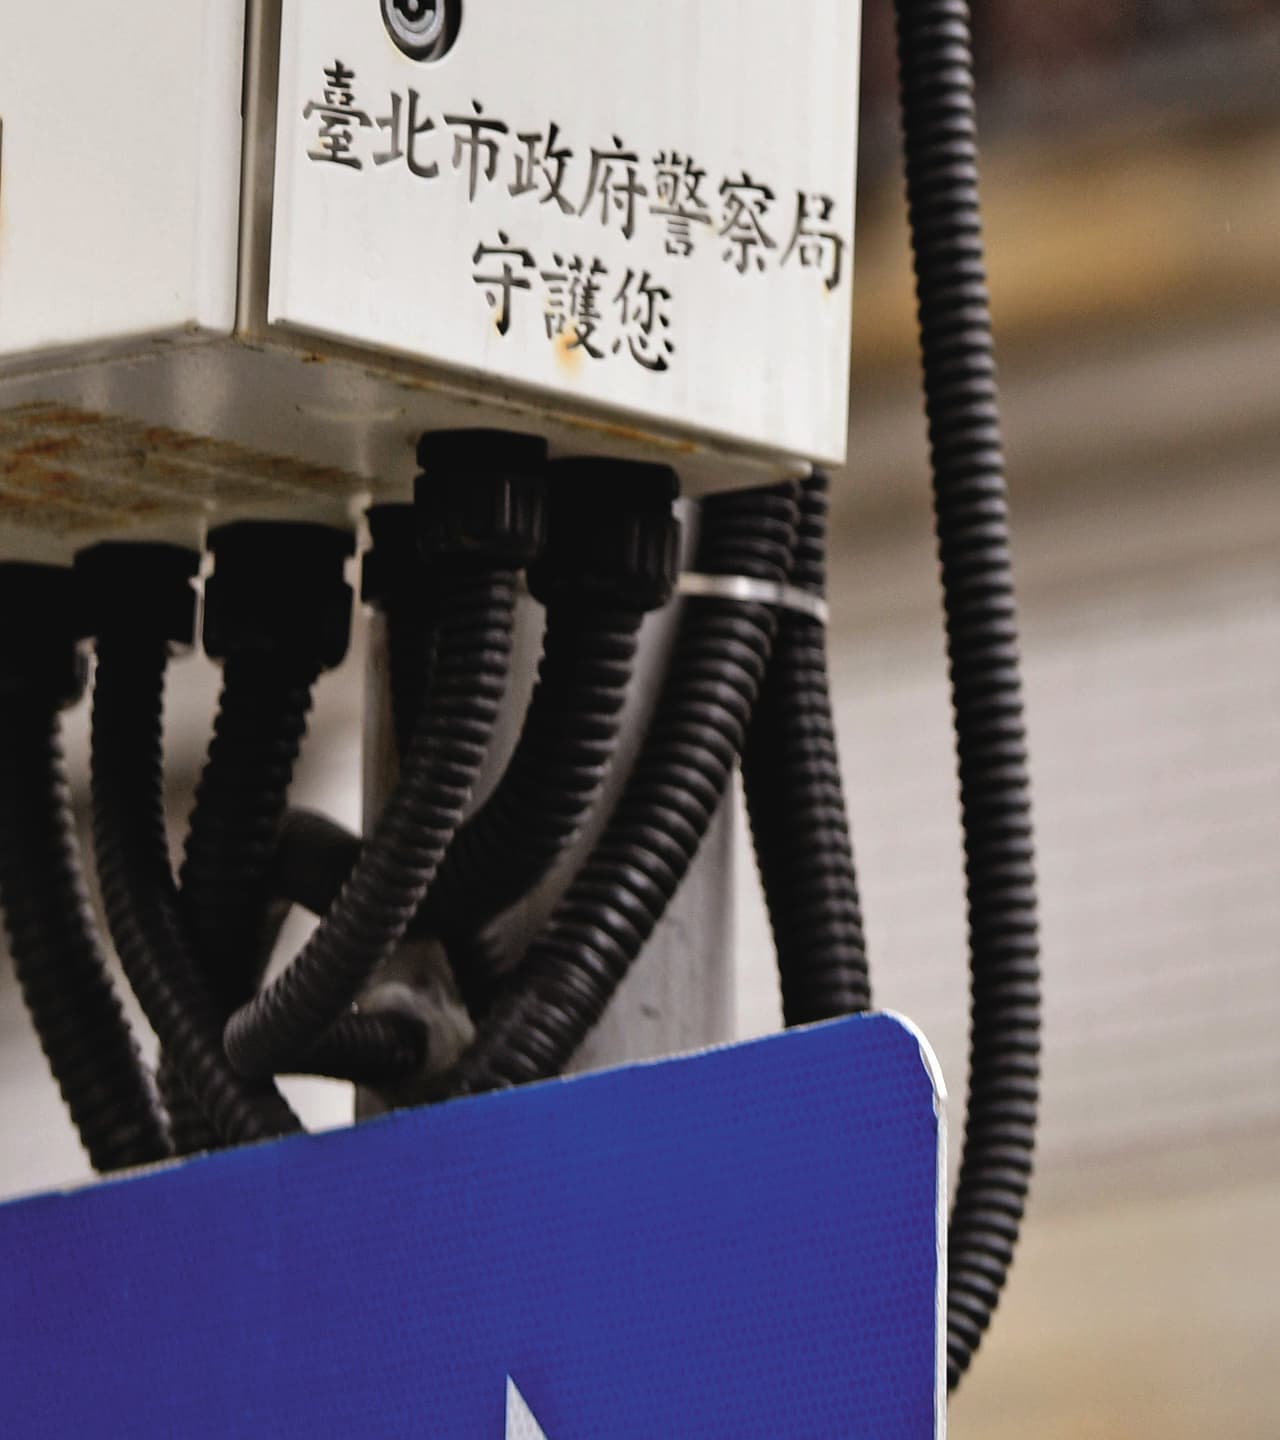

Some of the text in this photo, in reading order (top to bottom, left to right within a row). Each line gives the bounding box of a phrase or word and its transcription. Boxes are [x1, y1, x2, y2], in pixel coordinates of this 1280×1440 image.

[302, 59, 846, 293] 臺北市政府警察局
[471, 230, 675, 372] 守護您
